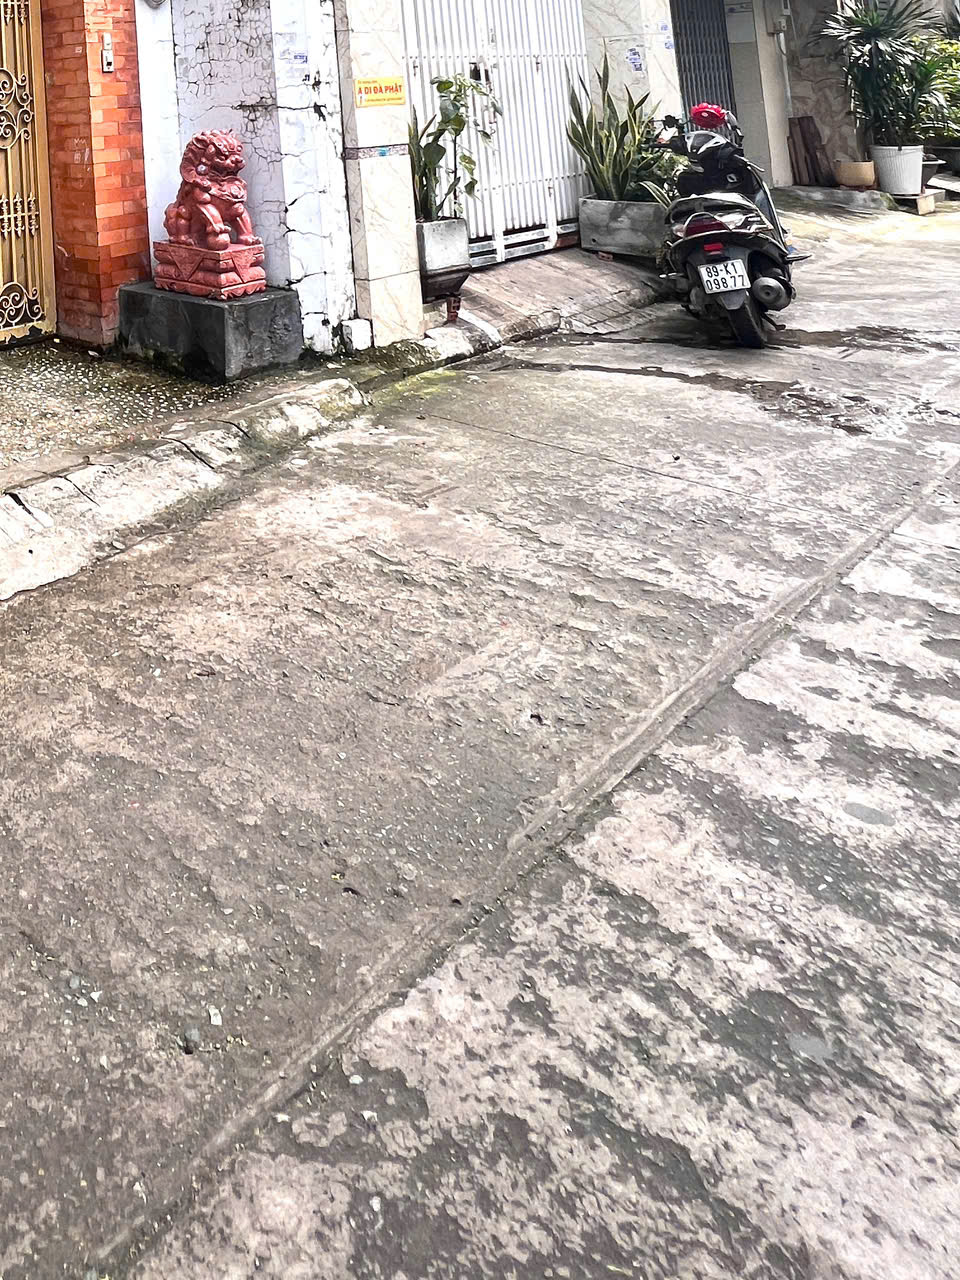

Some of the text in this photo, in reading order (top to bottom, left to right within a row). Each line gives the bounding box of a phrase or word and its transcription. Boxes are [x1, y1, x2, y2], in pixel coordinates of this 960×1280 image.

[357, 87, 363, 95] A
[364, 86, 372, 95] DI
[384, 83, 402, 95] PHẬT
[705, 262, 738, 278] 89-K1
